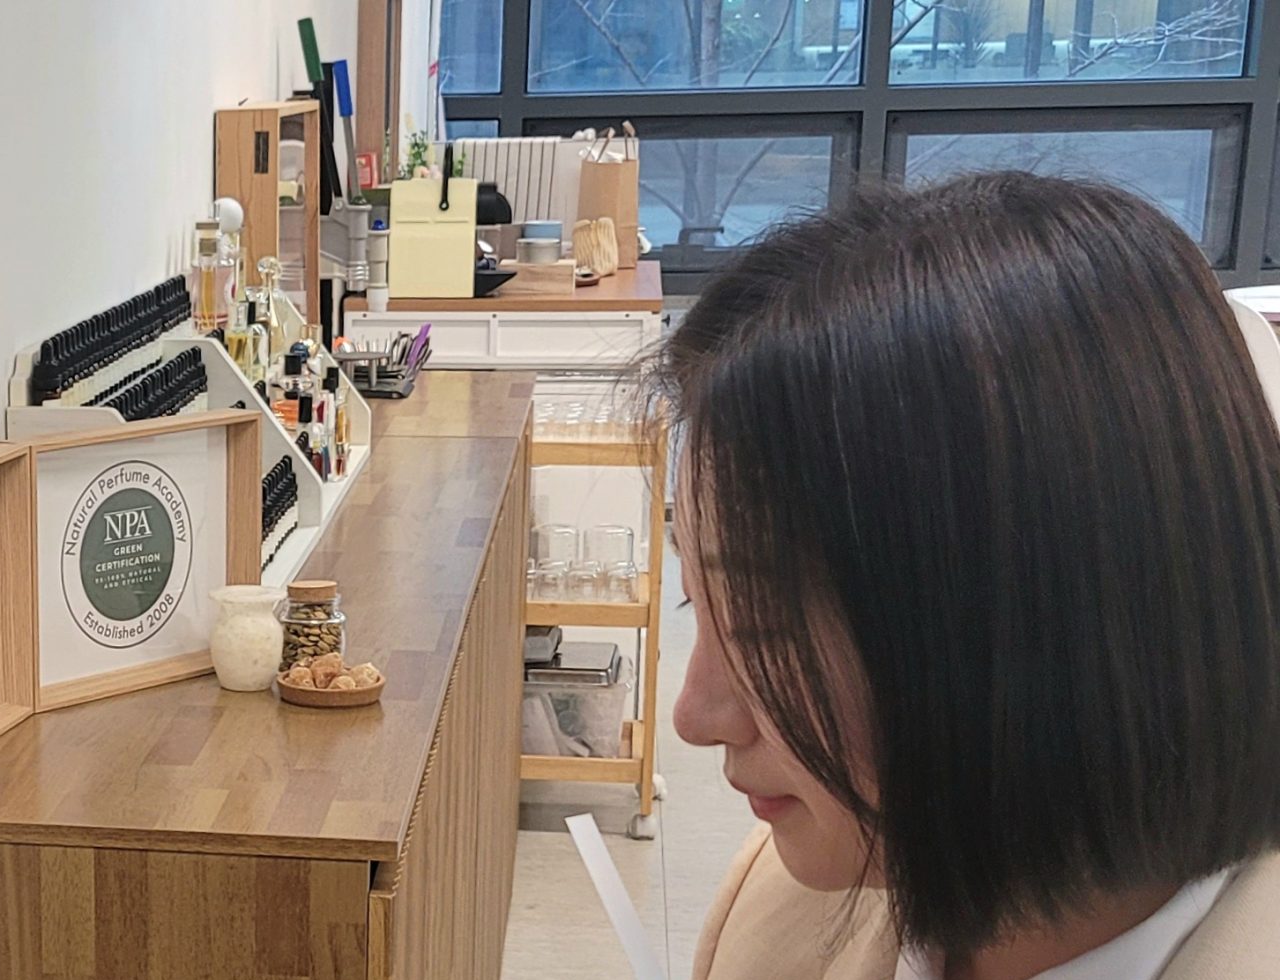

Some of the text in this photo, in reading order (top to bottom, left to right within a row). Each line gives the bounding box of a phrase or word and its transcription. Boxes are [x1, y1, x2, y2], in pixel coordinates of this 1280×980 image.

[64, 467, 187, 557] Natural Perfume Academy
[103, 510, 152, 541] NPA
[95, 553, 160, 572] CERTIFICATION
[113, 543, 143, 556] GREEN
[83, 592, 174, 640] Established 2008
